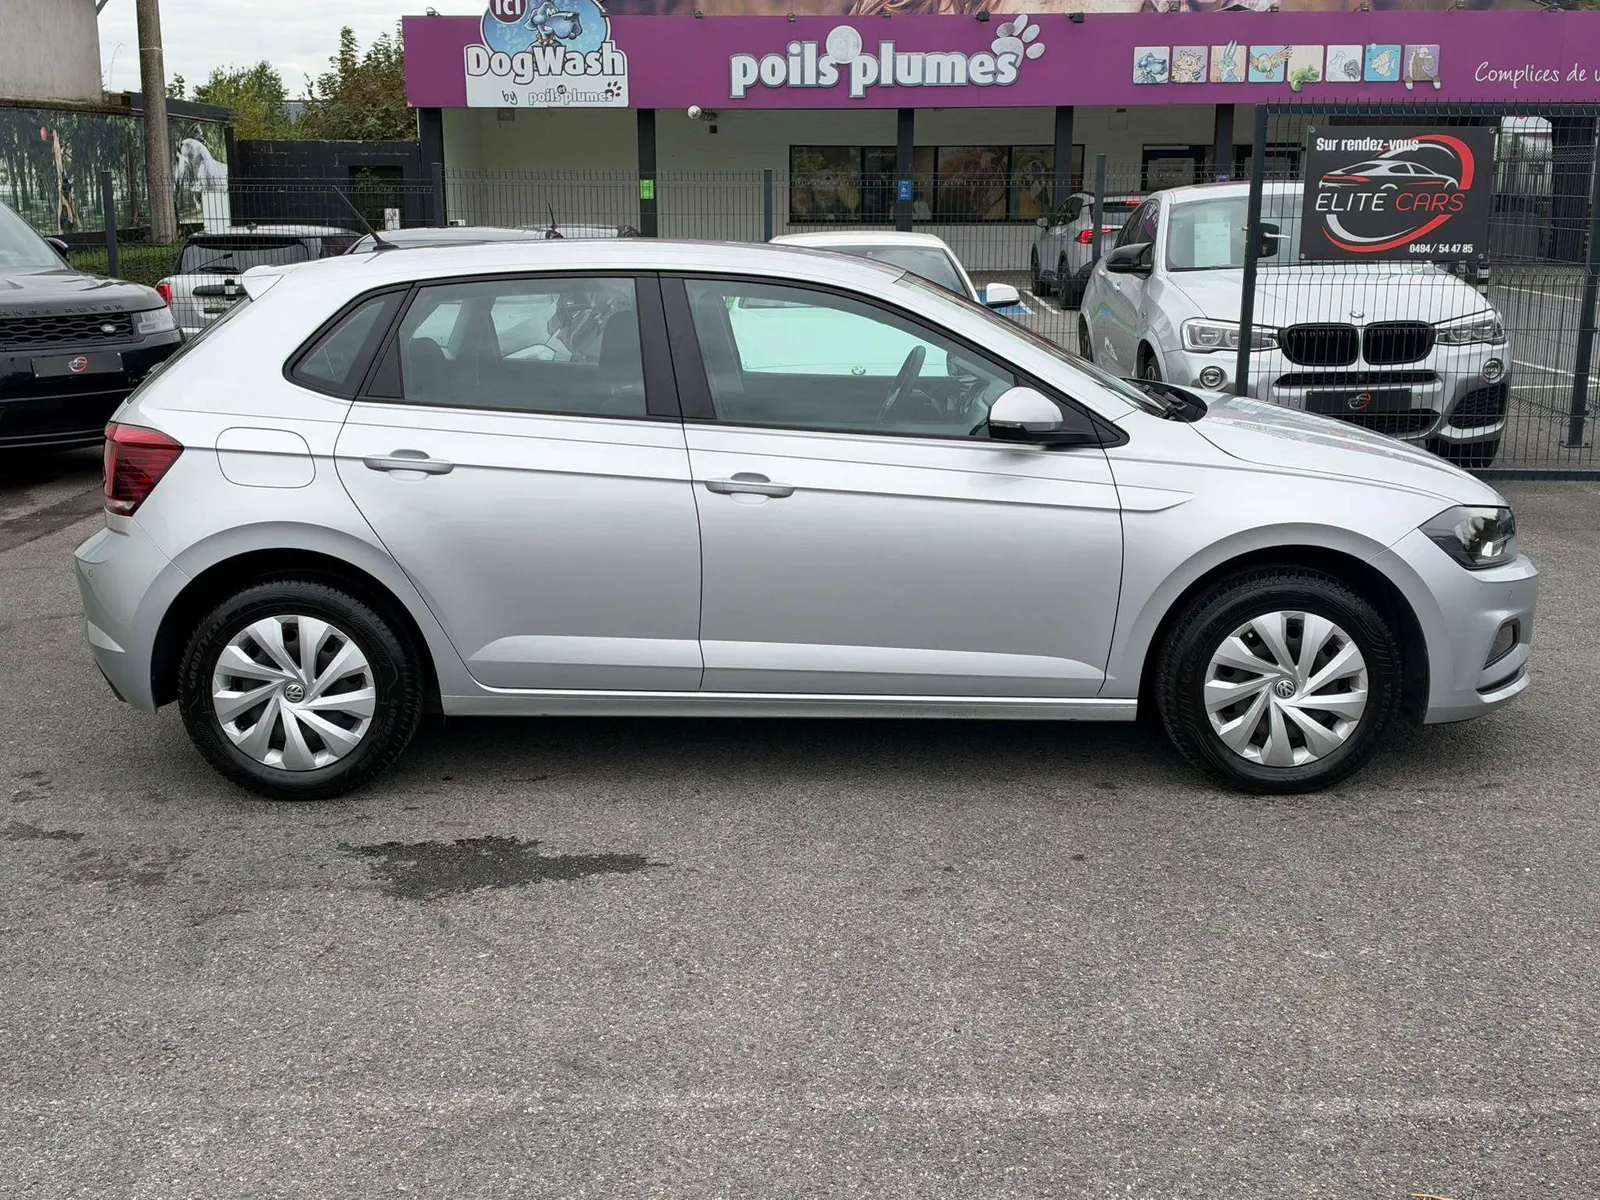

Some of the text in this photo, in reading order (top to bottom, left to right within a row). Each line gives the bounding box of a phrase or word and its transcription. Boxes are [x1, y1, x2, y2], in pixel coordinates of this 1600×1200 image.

[466, 41, 625, 85] DogWash
[729, 40, 1020, 98] poils plumes
[1474, 61, 1560, 89] Complices
[1566, 62, 1588, 82] de
[502, 90, 518, 105] by
[528, 88, 561, 106] poils
[563, 88, 614, 105] plumes
[1316, 137, 1419, 151] Sur rendez-vous
[1315, 193, 1466, 211] ELITE CARS
[1438, 243, 1449, 253] 54
[1450, 243, 1461, 253] 47
[1462, 243, 1473, 253] 85
